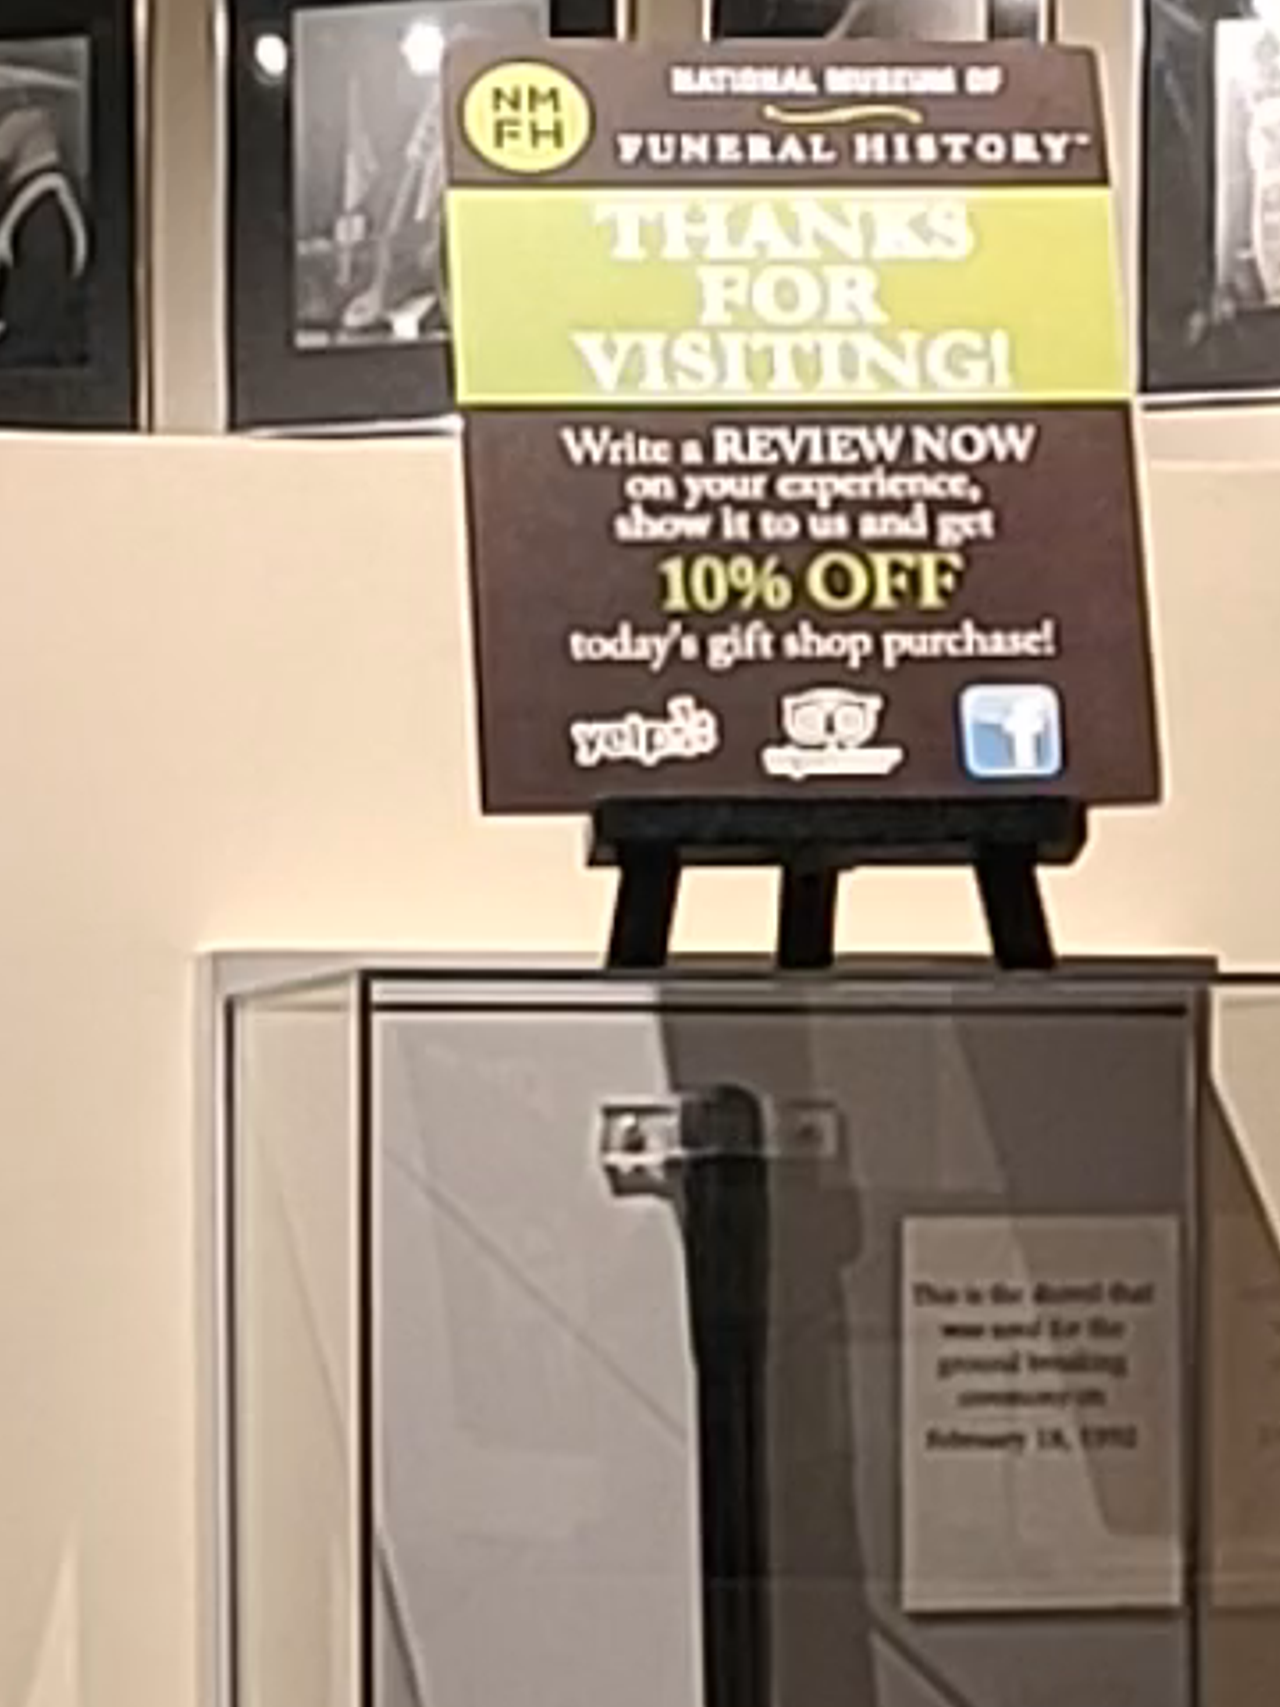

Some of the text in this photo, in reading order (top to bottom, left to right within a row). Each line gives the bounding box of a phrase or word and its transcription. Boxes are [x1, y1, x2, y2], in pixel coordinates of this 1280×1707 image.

[491, 86, 561, 114] NM
[670, 65, 1003, 95] NATIONAL MUSEUM OF
[493, 117, 564, 150] FH
[616, 133, 837, 164] FUNERAL
[592, 198, 976, 261] THANKS
[695, 263, 890, 327] FOR
[568, 327, 1014, 392] VISITING!
[559, 423, 1037, 466] Write a REVIEW NOW
[623, 464, 982, 511] on your experience,
[613, 501, 996, 549] show it to us and get
[657, 549, 965, 612] 10% OFF
[569, 617, 1058, 673] today's gift shop purchase!
